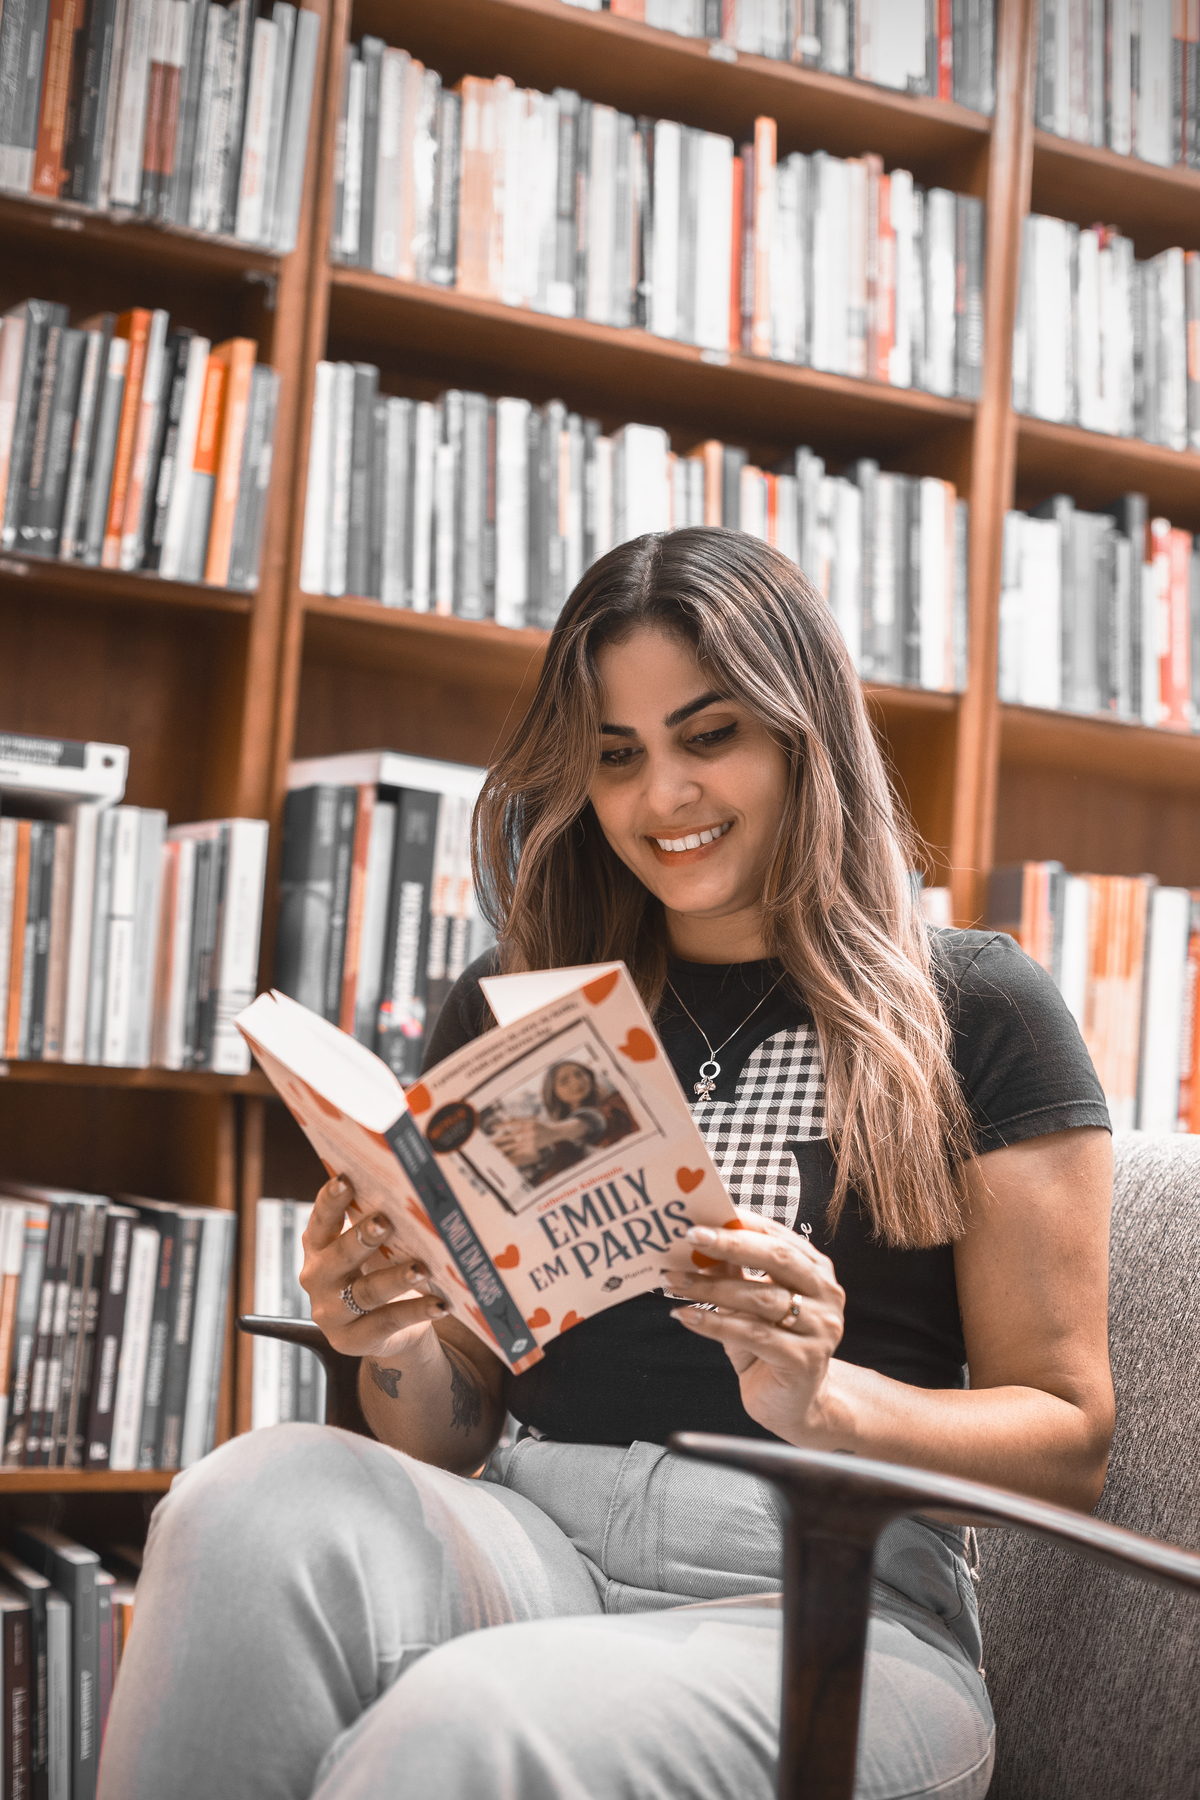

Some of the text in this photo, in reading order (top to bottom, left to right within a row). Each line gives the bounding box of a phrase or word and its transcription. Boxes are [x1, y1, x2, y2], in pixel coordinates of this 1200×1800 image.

[528, 1200, 695, 1292] EM PARIS
[538, 1166, 652, 1249] EMILY
[440, 1208, 503, 1307] EMILY EM PARIS
